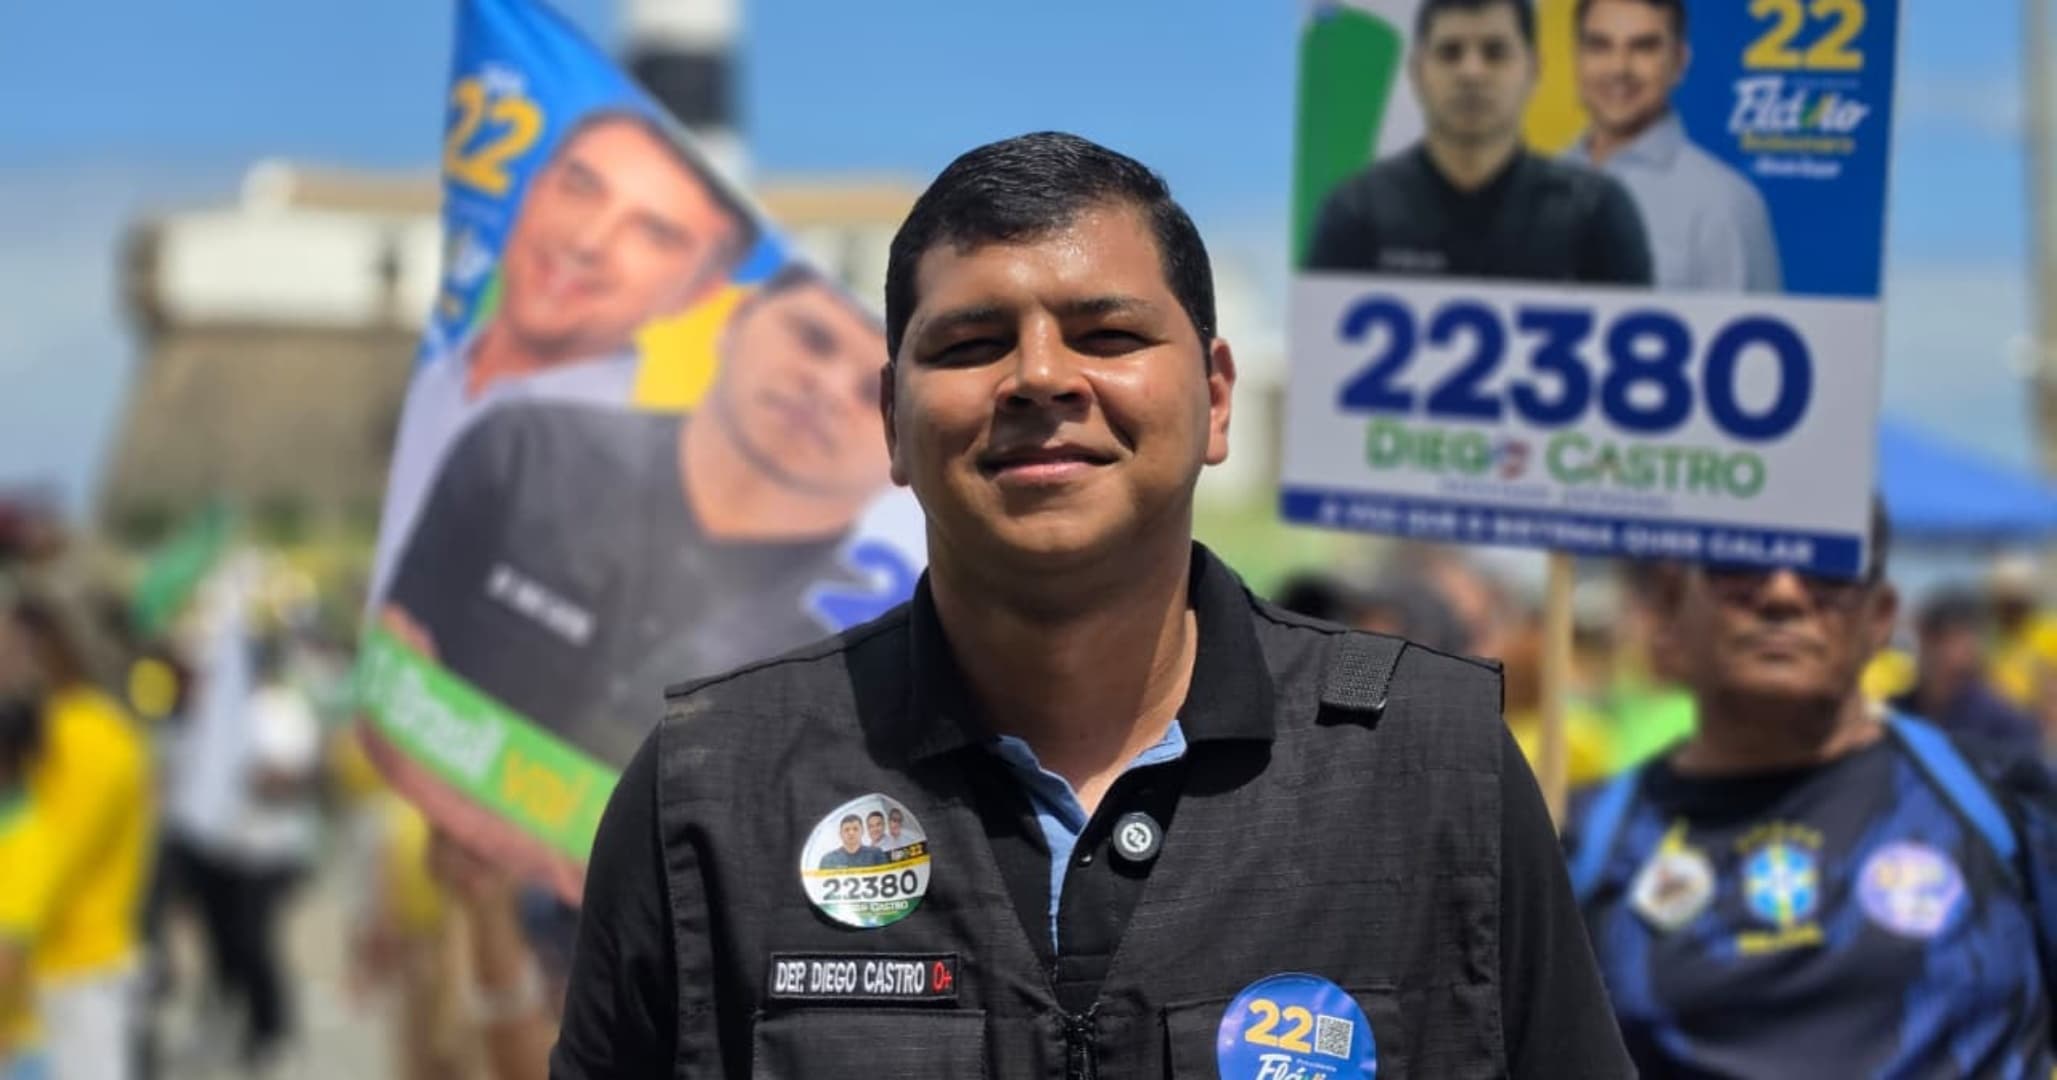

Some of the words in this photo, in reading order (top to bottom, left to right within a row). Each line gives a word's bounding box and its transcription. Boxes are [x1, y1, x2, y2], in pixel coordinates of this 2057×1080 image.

[1742, 0, 1865, 70] 22
[443, 77, 546, 196] 22
[1335, 293, 1813, 444] 22380
[1545, 430, 1766, 499] CASTRO
[823, 869, 919, 900] 22380
[810, 962, 858, 992] DIEGO
[863, 962, 926, 992] CASTRO
[1244, 998, 1314, 1054] 22
